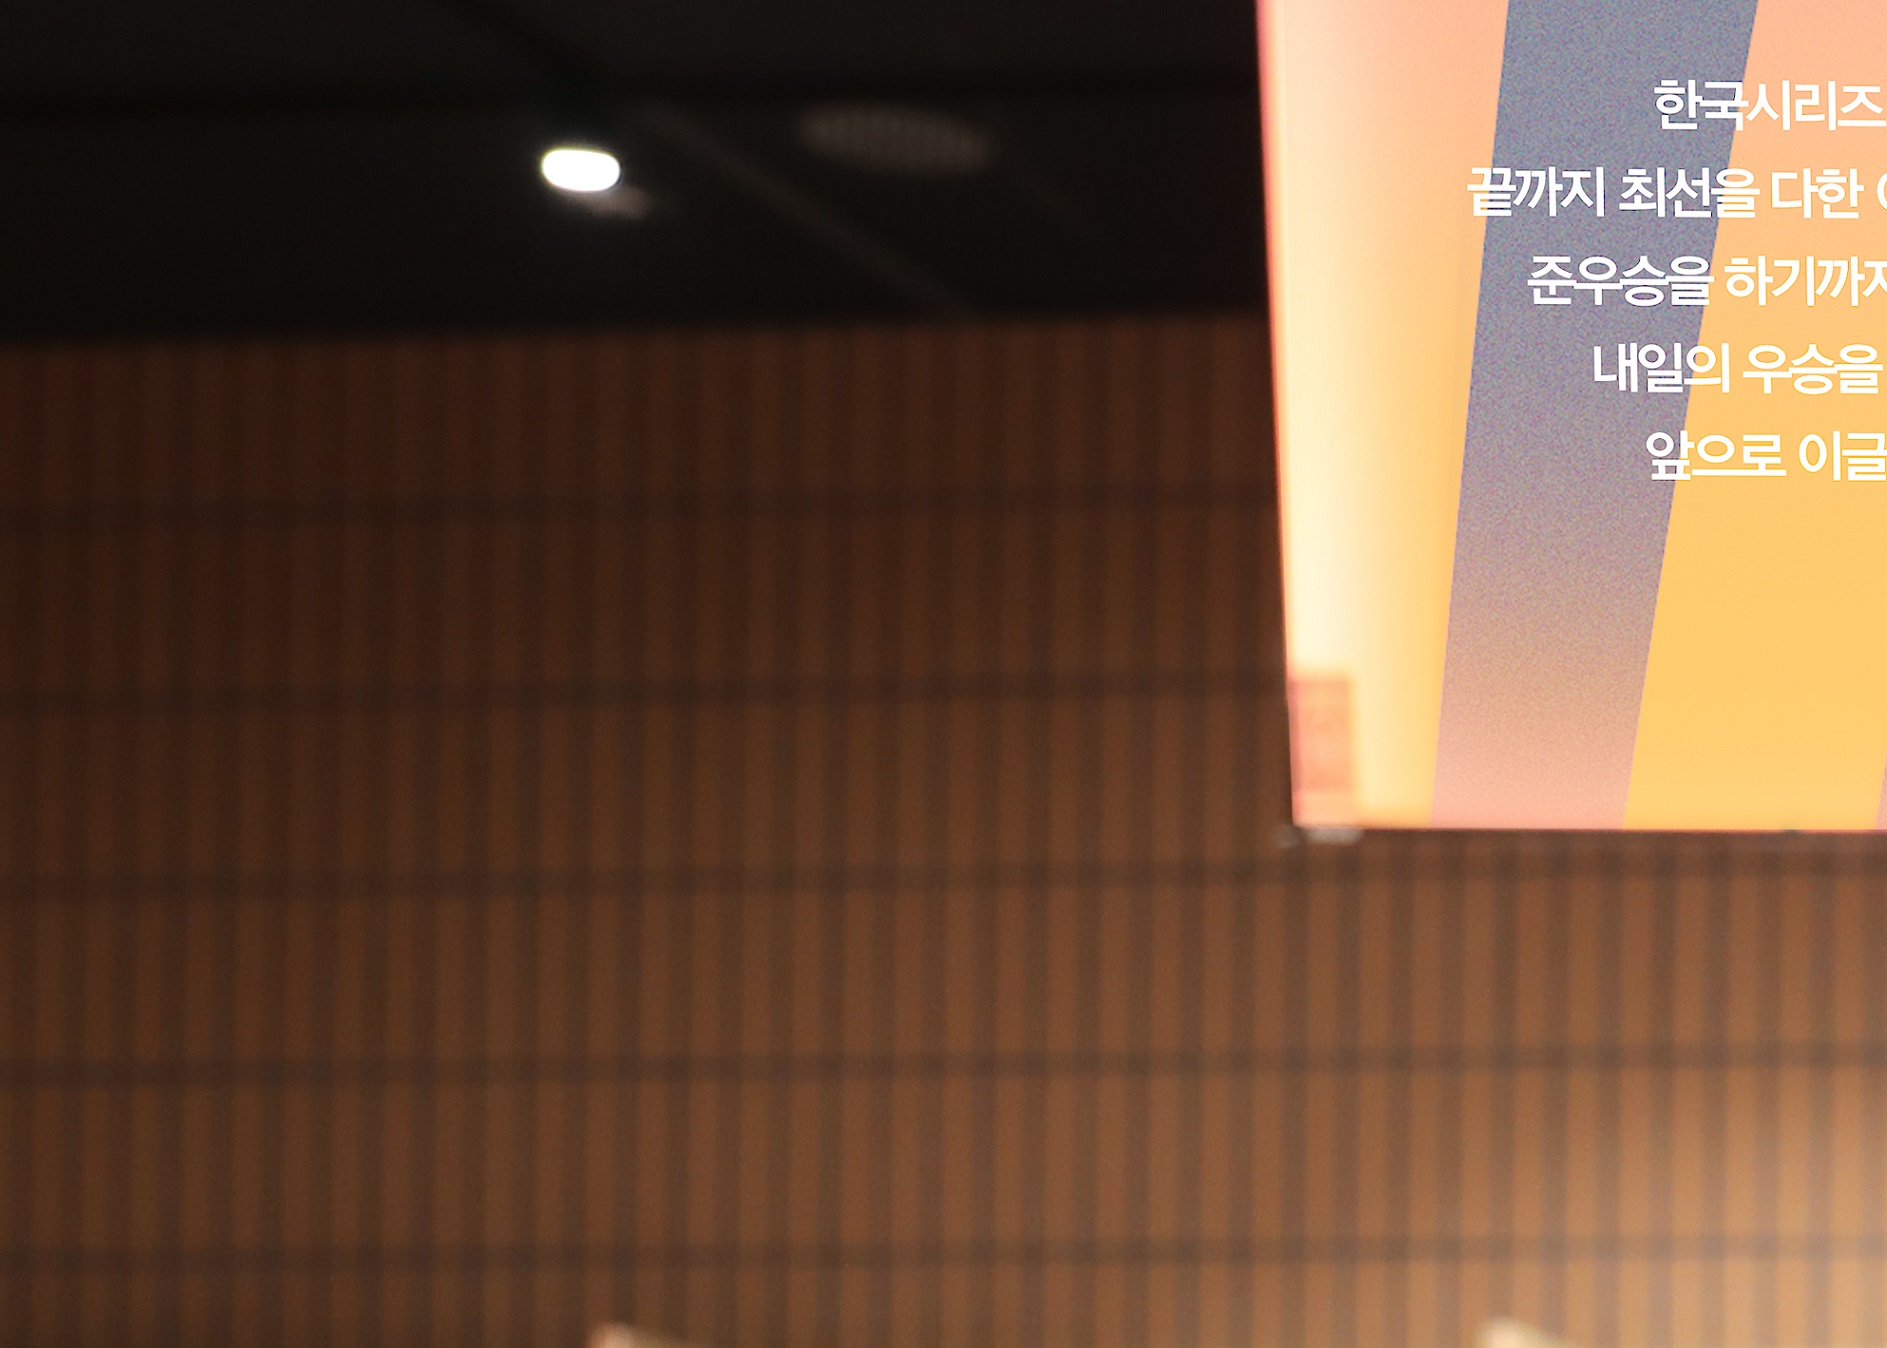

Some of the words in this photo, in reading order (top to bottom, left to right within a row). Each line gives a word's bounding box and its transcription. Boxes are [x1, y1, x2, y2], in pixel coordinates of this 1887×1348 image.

[1654, 79, 1887, 131] 한국시리즈
[1467, 166, 1605, 217] 끝까지
[1619, 167, 1760, 218] 최선을
[1771, 168, 1864, 219] 다한
[1527, 255, 1714, 307] 준우승을
[1593, 342, 1730, 393] 내일의
[1743, 344, 1883, 395] 우승을
[1646, 430, 1786, 480] 앞으로
